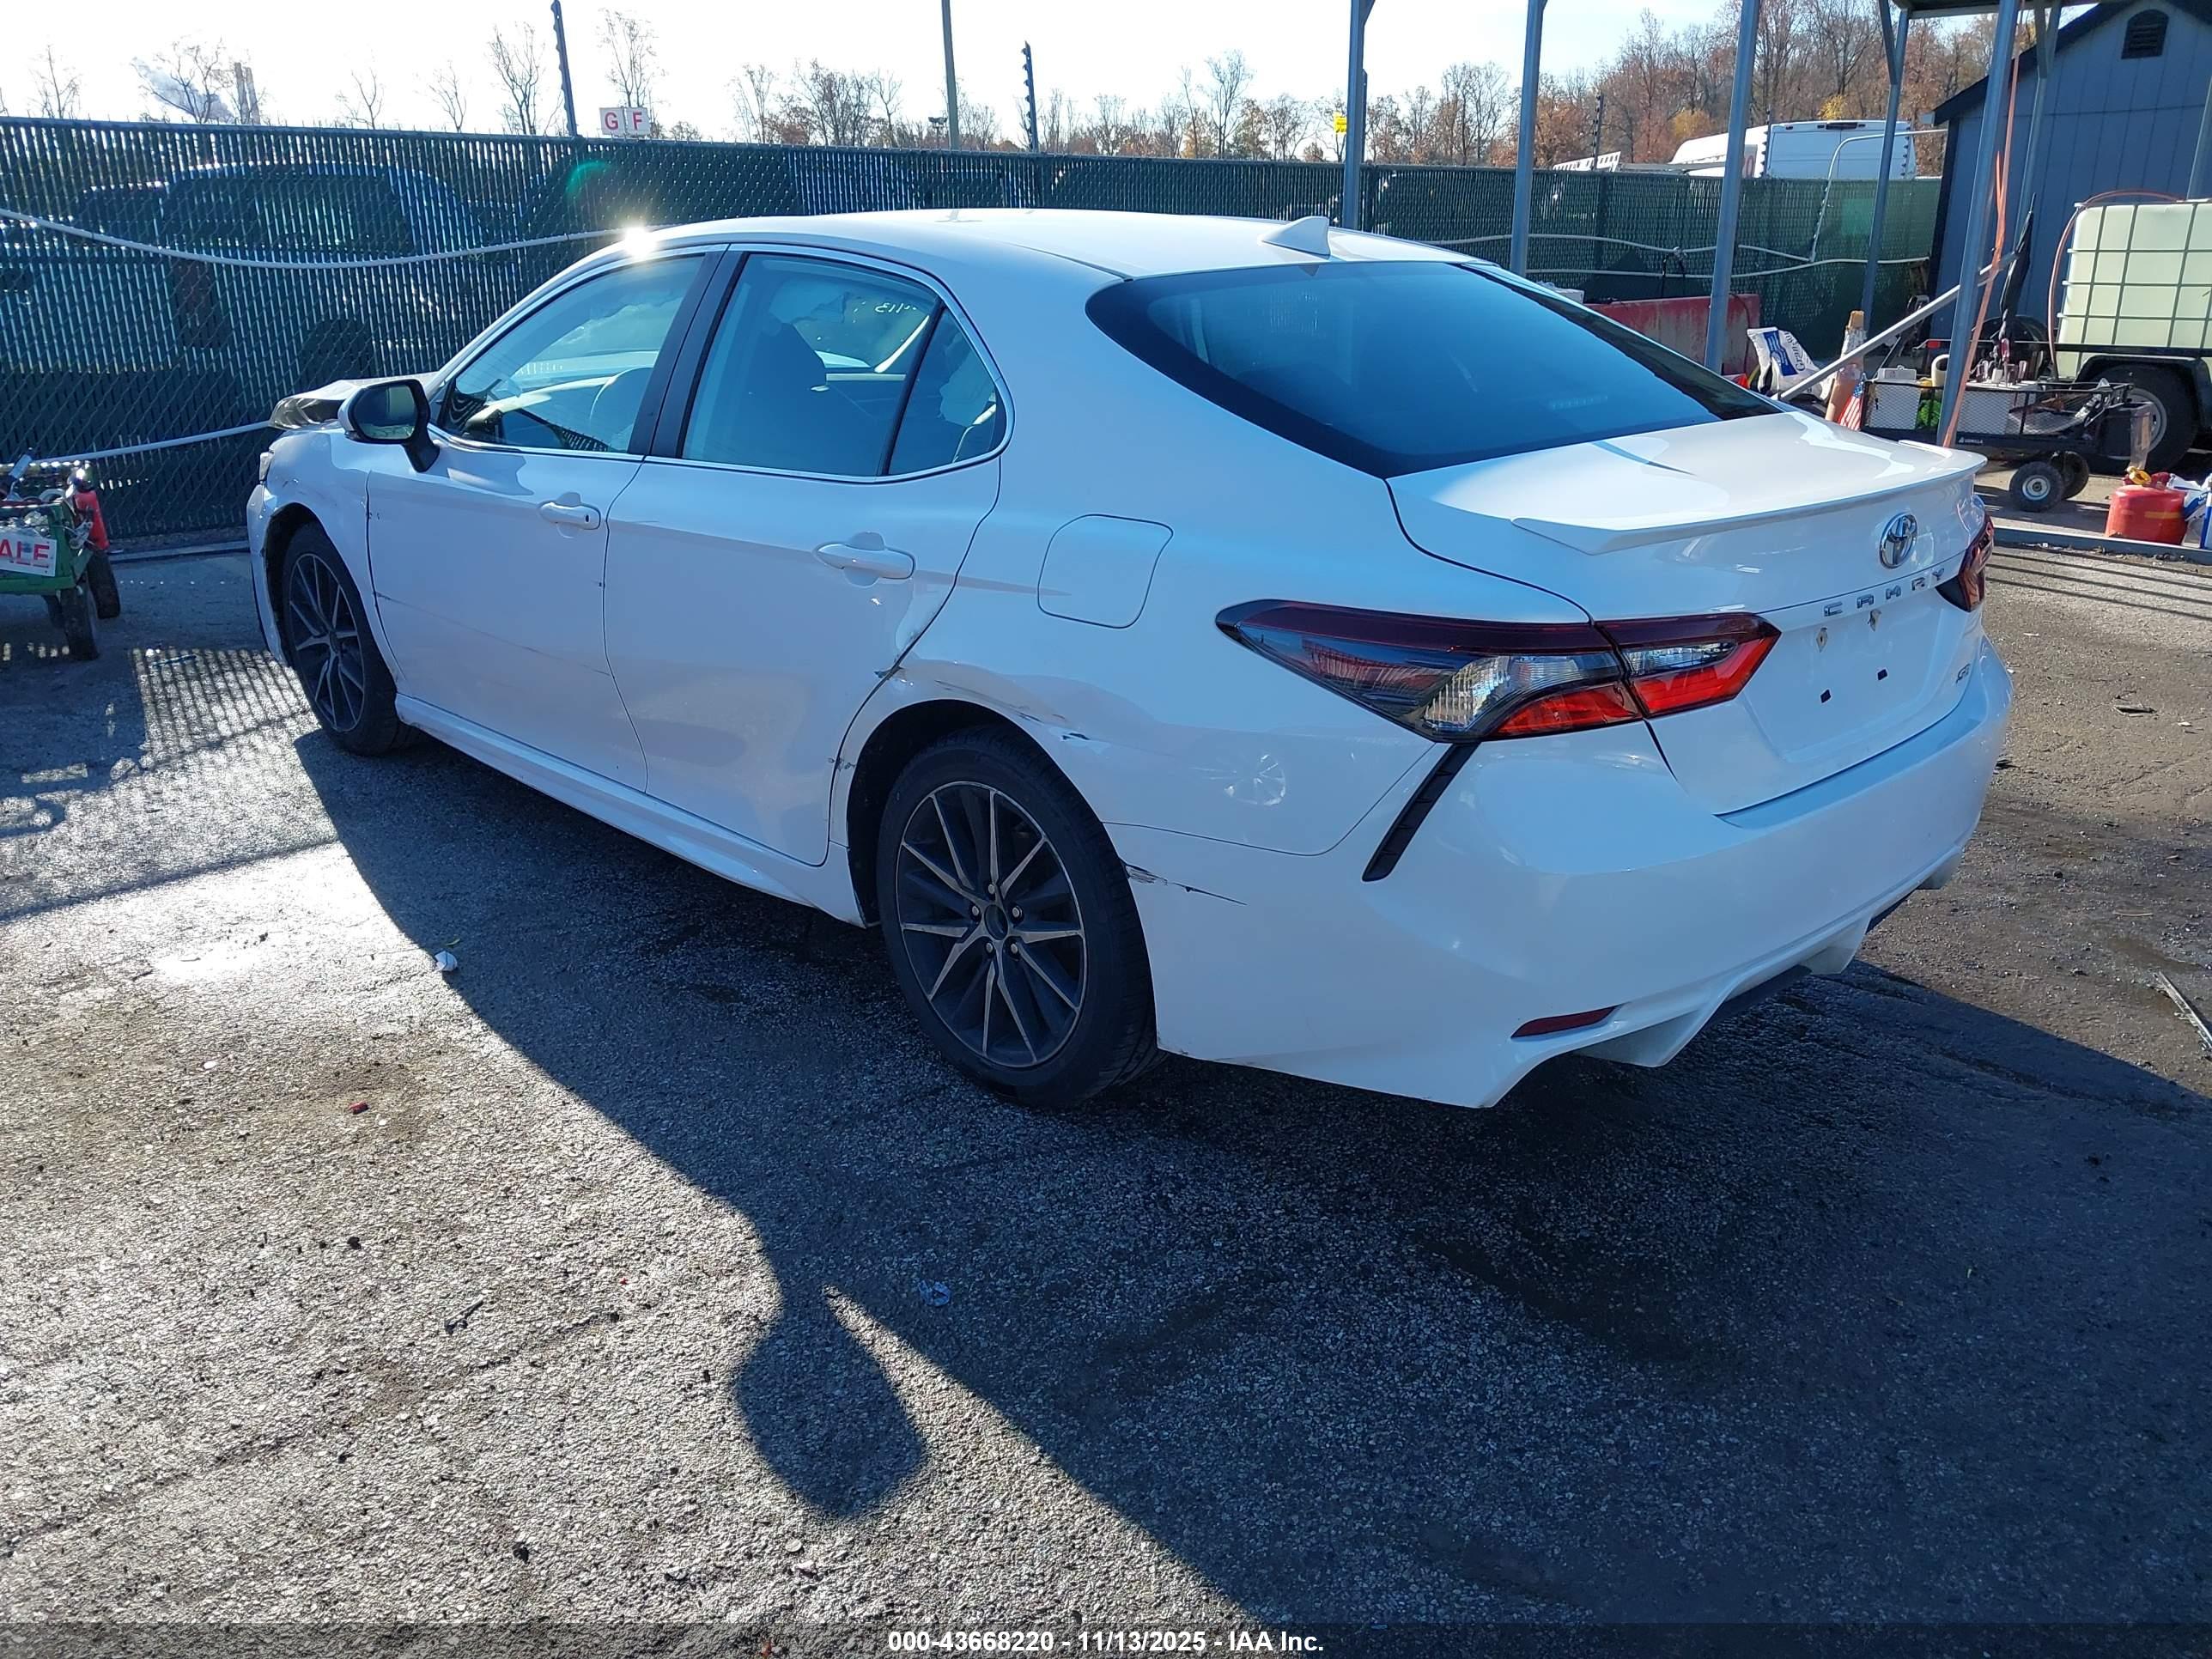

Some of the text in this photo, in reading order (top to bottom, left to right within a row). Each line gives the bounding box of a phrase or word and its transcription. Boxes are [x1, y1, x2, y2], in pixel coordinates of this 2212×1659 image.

[605, 112, 642, 131] G F
[1823, 568, 1945, 617] CAMRY
